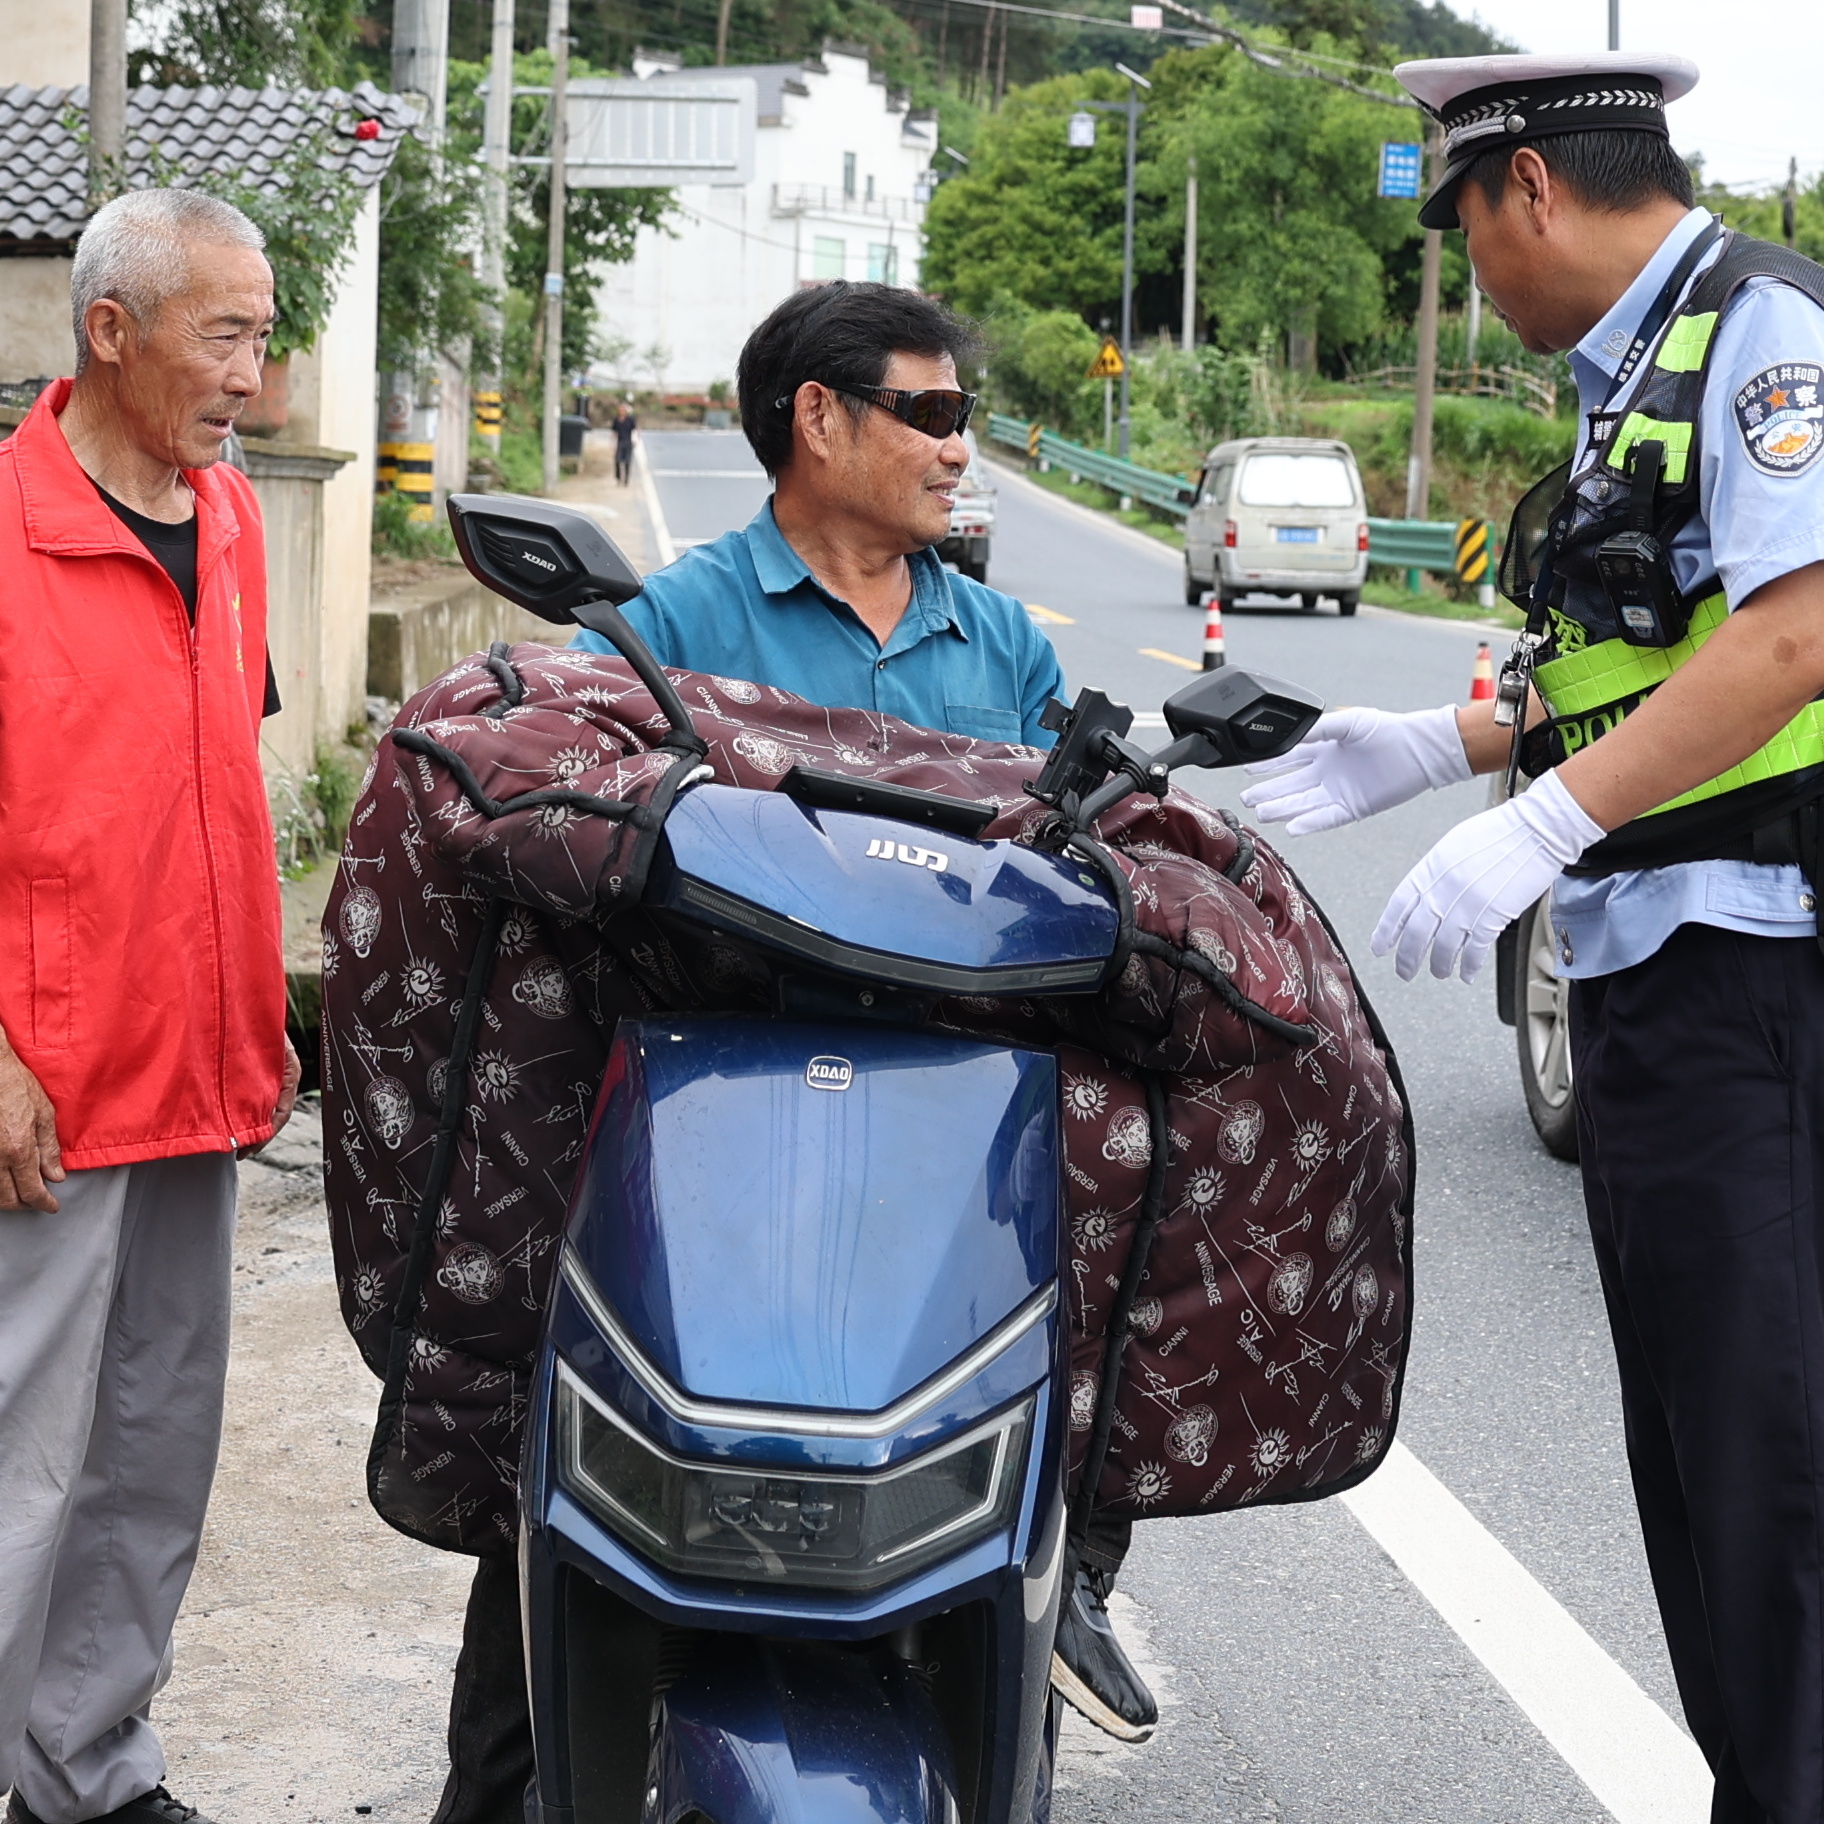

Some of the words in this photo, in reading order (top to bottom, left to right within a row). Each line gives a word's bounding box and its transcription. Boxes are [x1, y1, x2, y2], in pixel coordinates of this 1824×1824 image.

[1736, 366, 1820, 410] 中华人民共和国
[1794, 384, 1819, 407] 察
[1343, 1083, 1358, 1122] CIANNI
[1248, 1157, 1280, 1207] VERSAGE
[484, 1185, 530, 1218] VERSAGE
[1193, 1240, 1223, 1308] ANNIVERSAGE
[1158, 1325, 1189, 1358] CIANNI
[1308, 1391, 1330, 1429] CIANNI
[411, 1450, 456, 1482] VERSAGE
[1200, 1461, 1236, 1506] VERSAGE
